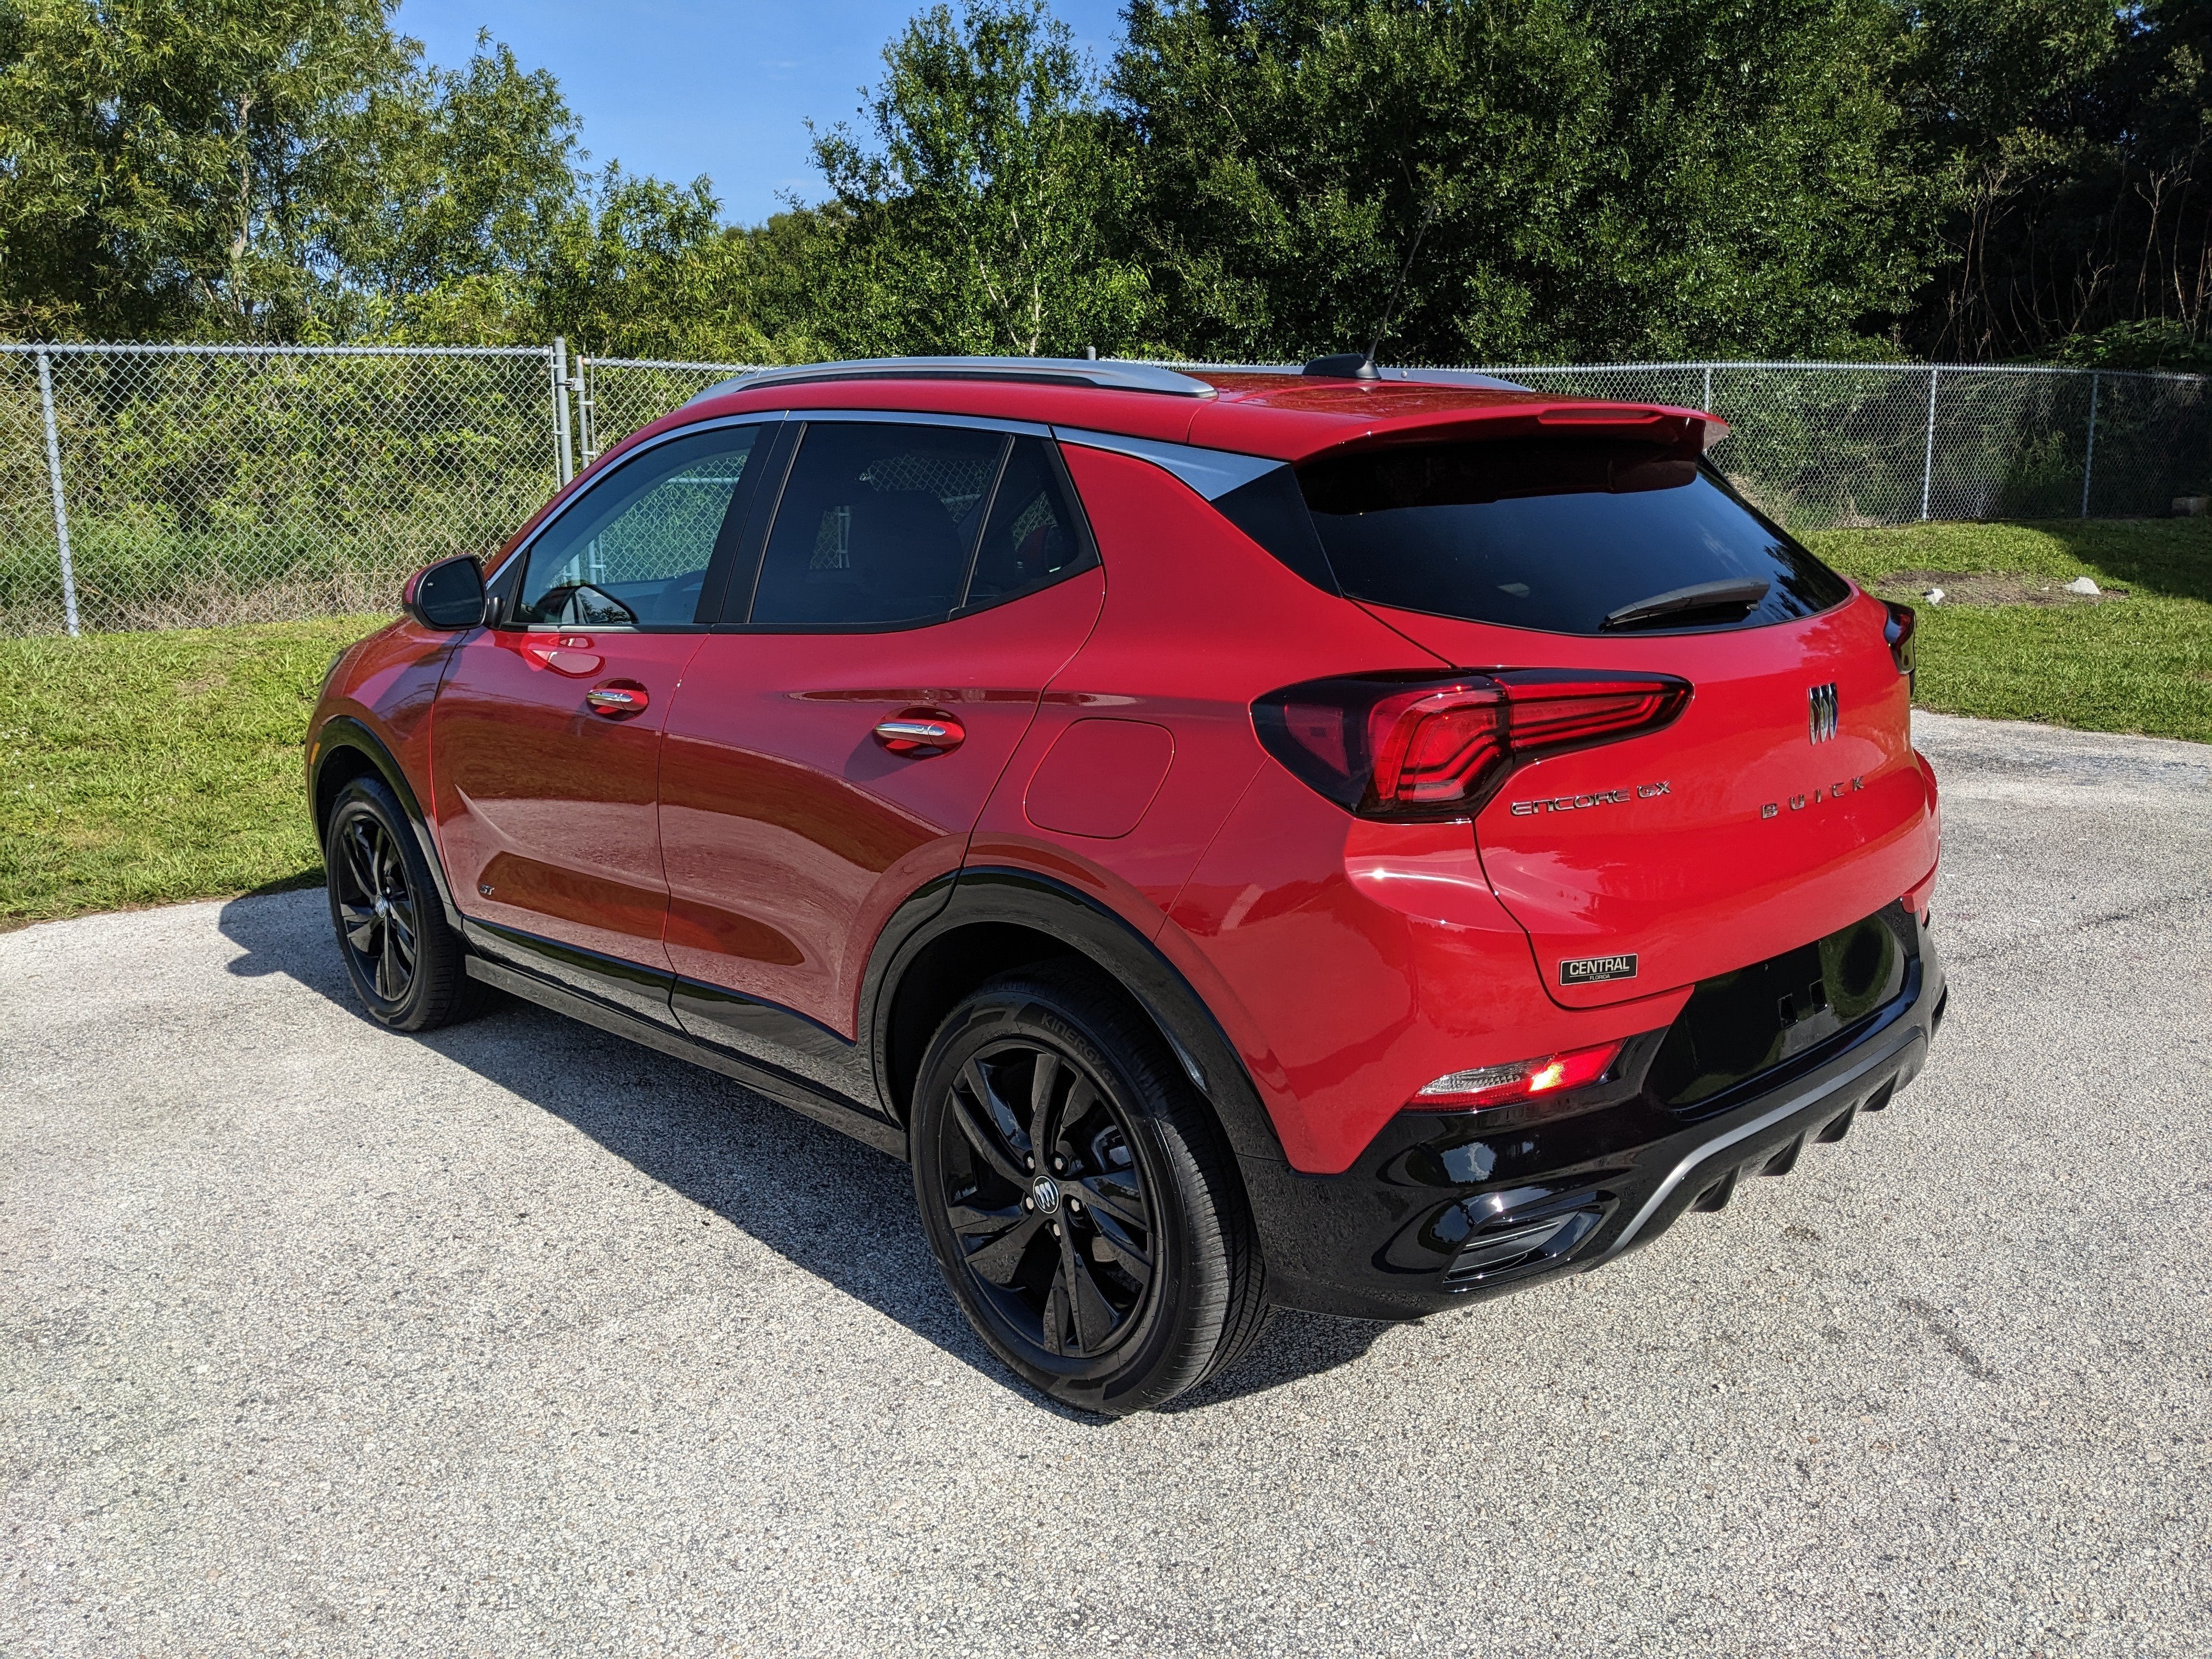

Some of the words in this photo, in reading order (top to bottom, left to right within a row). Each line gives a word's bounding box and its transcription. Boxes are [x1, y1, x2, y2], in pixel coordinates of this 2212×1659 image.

[1510, 788, 1630, 816] ENCORE
[1637, 780, 1672, 798] GX
[1761, 775, 1865, 820] BUICK
[479, 884, 495, 895] ST
[1569, 957, 1630, 975] CENTRAL
[1041, 1013, 1107, 1065] KINERGY
